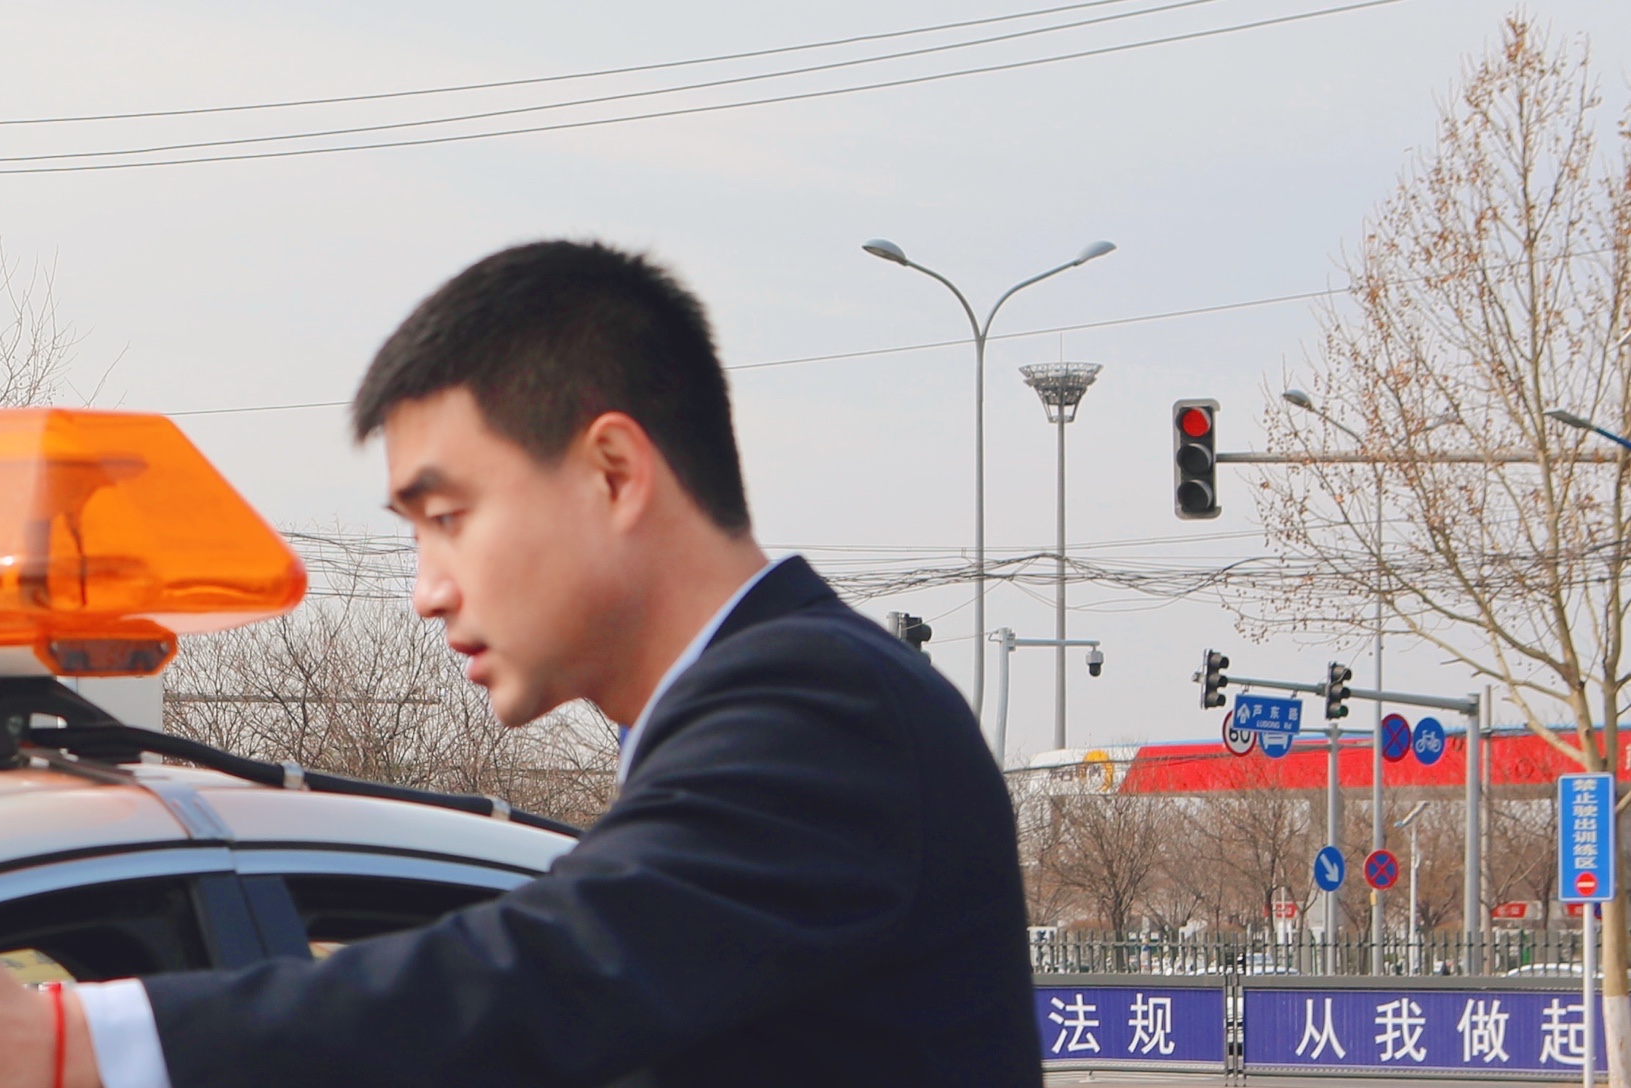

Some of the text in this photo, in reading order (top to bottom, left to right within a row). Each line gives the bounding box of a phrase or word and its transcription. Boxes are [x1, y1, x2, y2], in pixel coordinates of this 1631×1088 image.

[1572, 779, 1598, 869] 禁止驶出训练区
[1047, 993, 1597, 1066] 法规 从我做起
